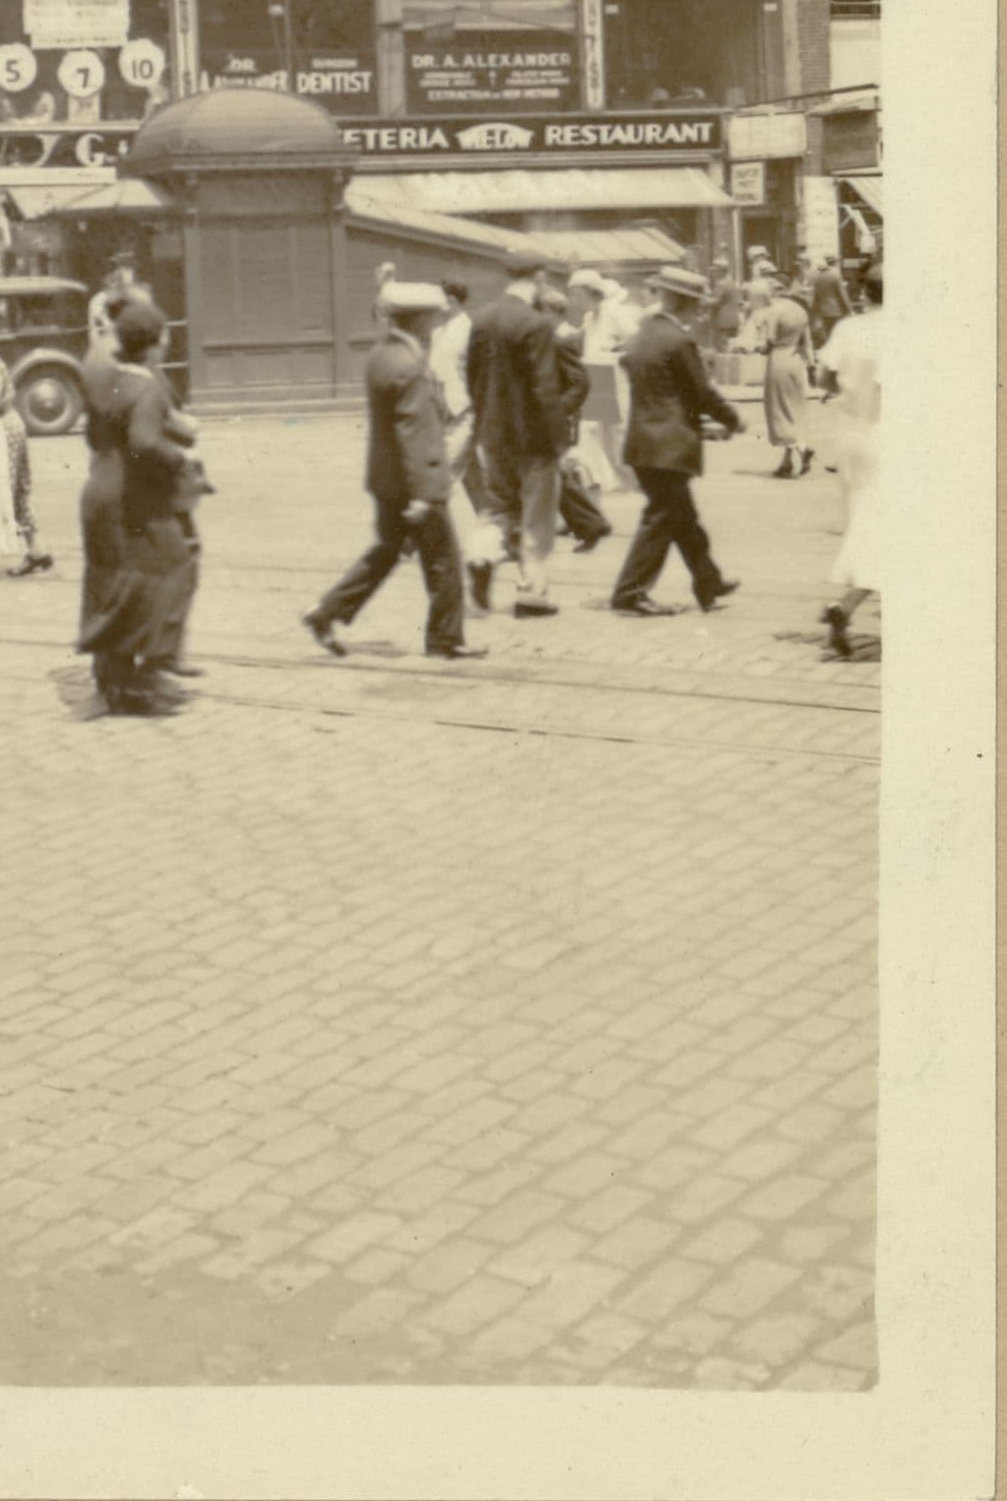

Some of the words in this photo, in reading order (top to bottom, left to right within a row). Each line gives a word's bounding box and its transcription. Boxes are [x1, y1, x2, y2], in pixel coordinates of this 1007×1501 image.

[5, 59, 22, 83] 5
[131, 59, 155, 81] 10
[462, 53, 572, 69] ALEXANDER
[76, 68, 91, 89] 7
[296, 71, 372, 93] DENTIST
[338, 127, 450, 150] ETERIA
[545, 121, 714, 145] RESTAURANT
